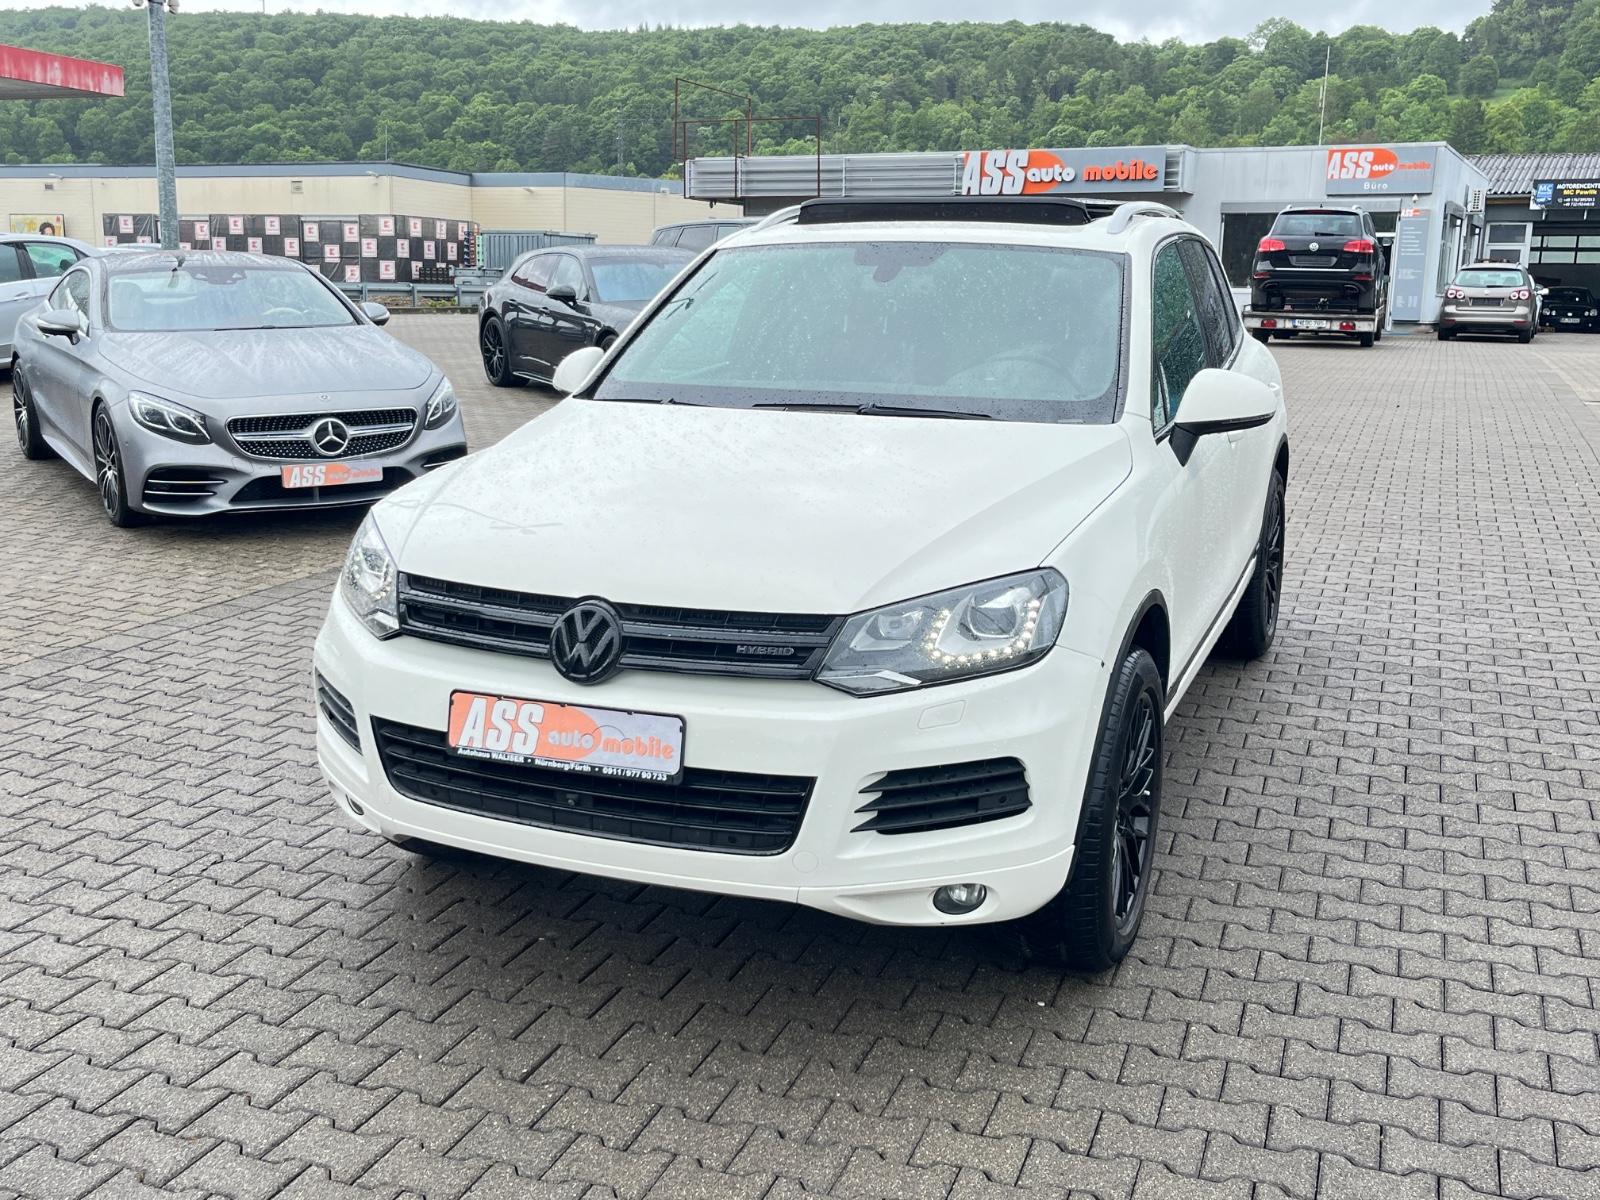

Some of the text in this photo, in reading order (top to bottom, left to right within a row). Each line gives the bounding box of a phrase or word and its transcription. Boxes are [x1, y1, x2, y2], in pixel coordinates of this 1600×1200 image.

[962, 150, 1159, 195] ASS auto mobile
[1328, 151, 1374, 179] ASS
[288, 465, 326, 487] ASS
[736, 644, 794, 656] HYBRID
[458, 696, 675, 760] ASS auto mobile
[458, 747, 490, 758] Autohaus
